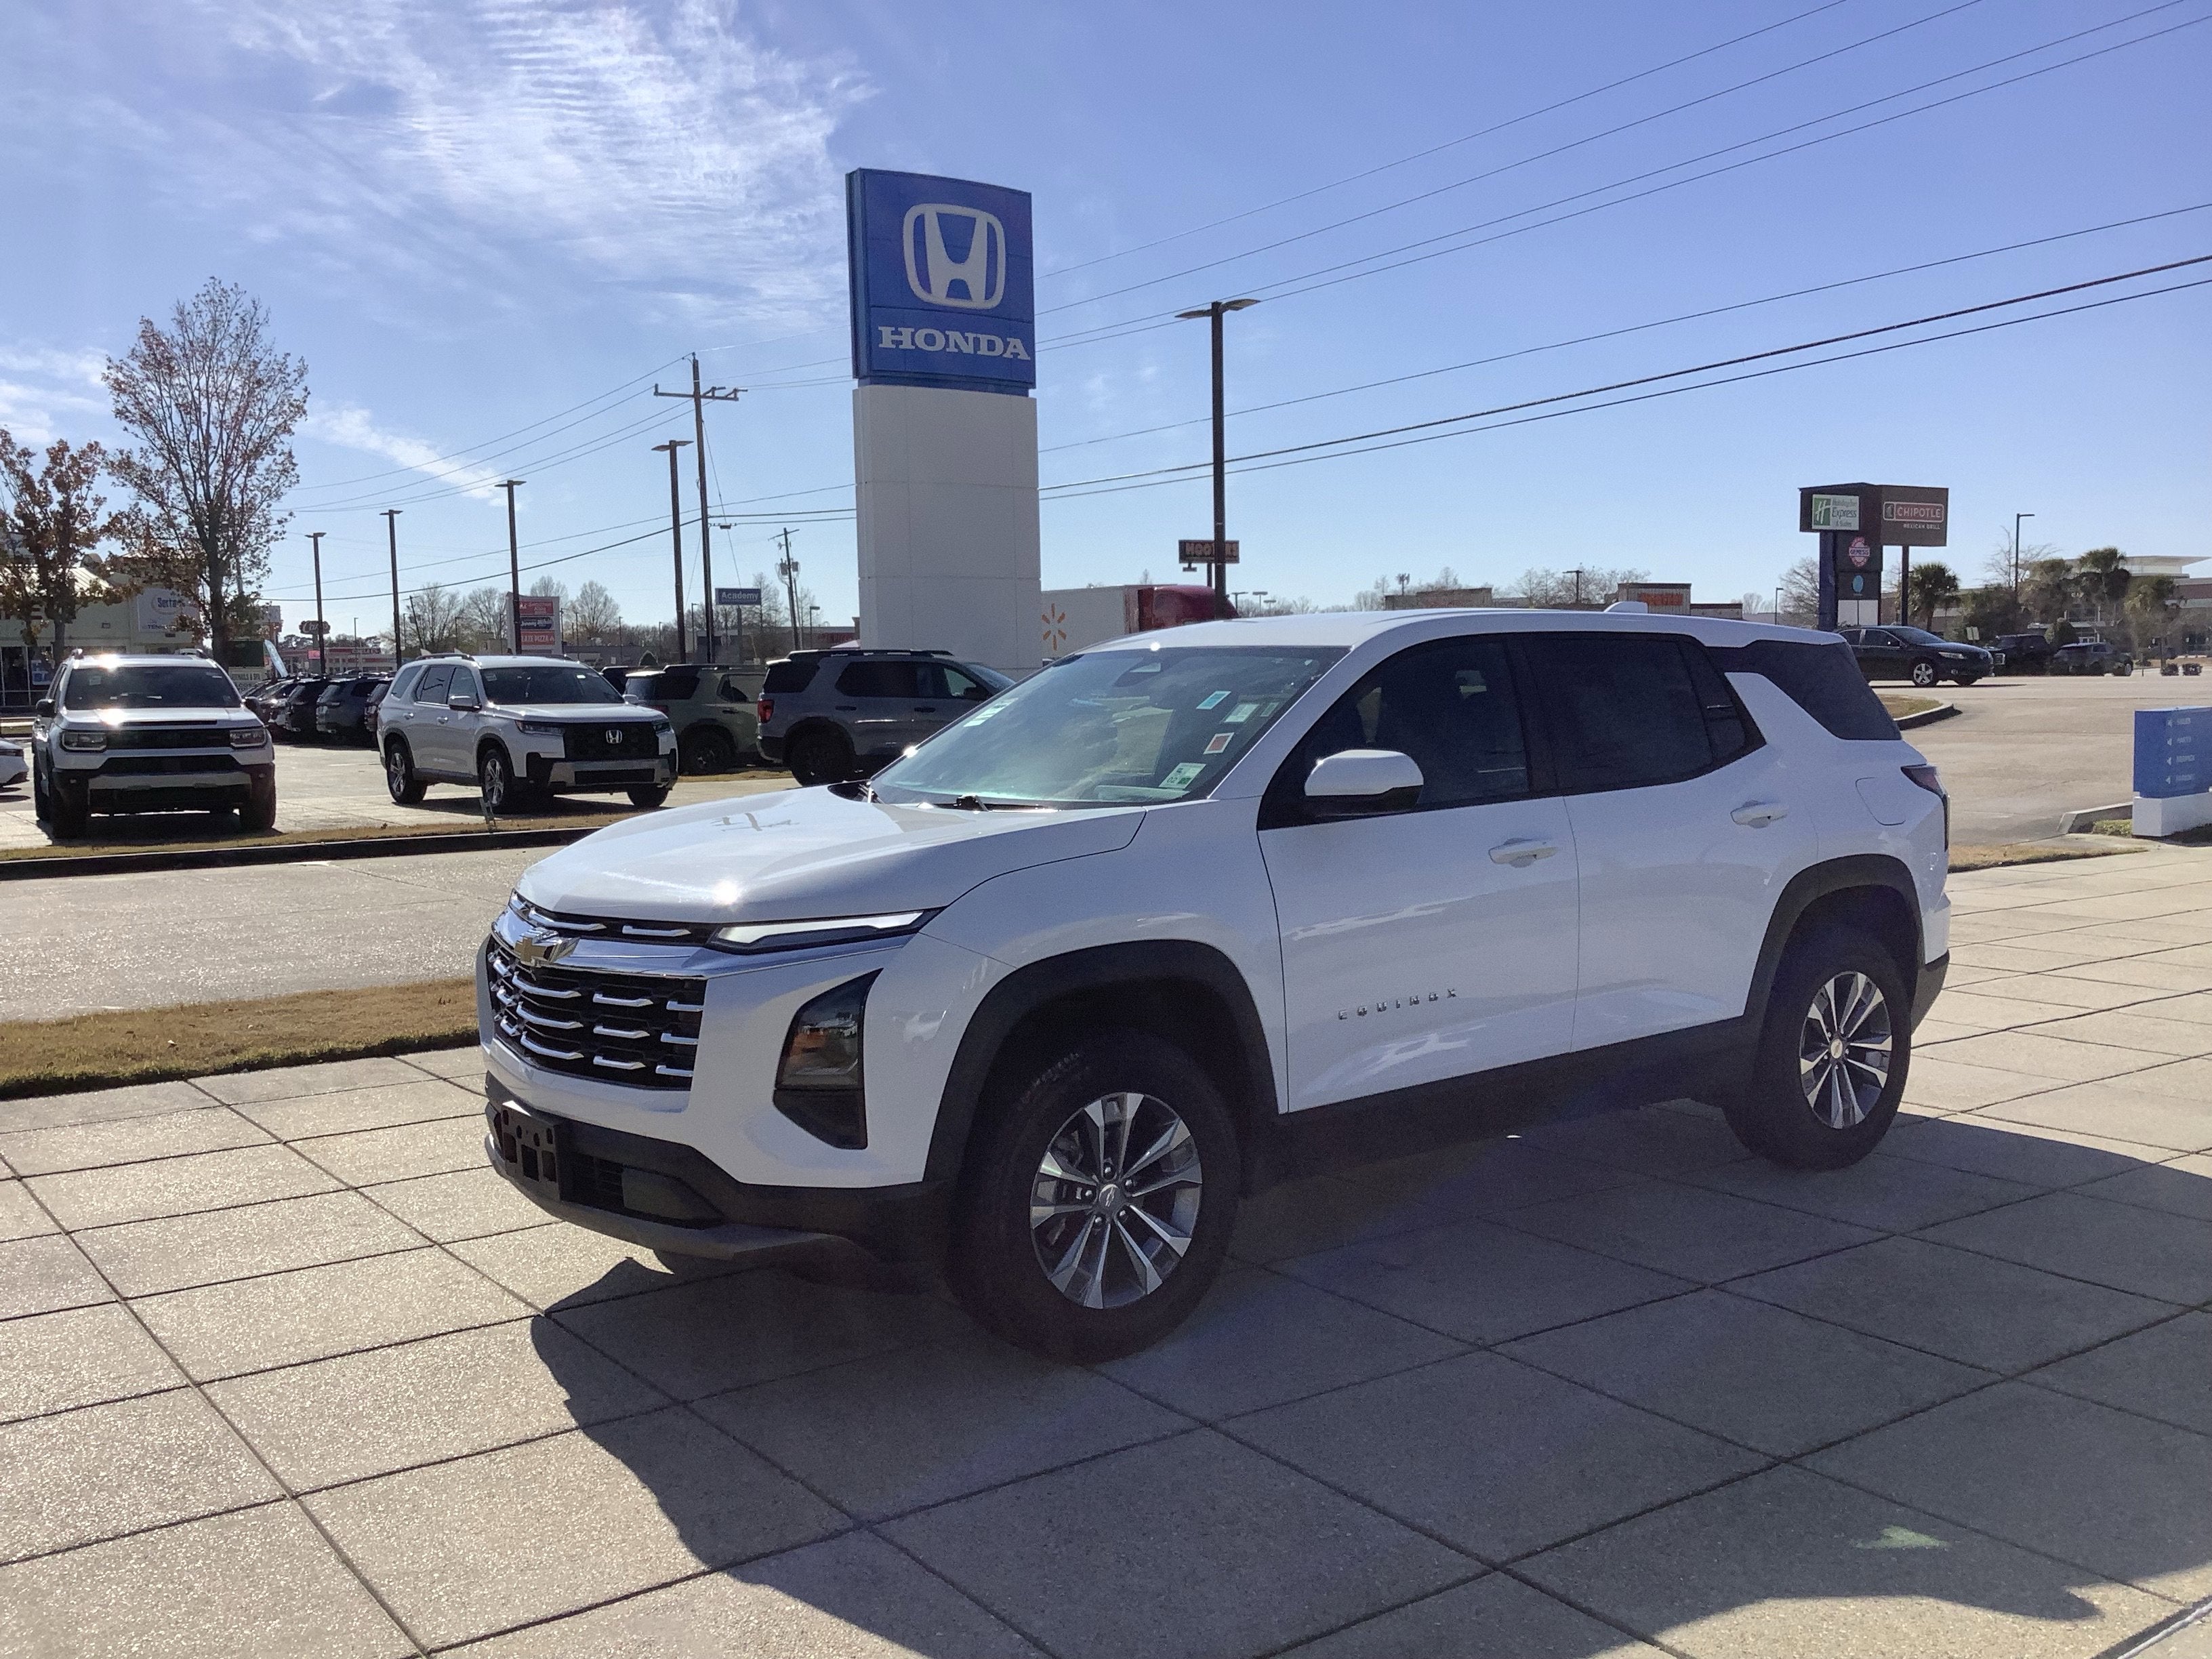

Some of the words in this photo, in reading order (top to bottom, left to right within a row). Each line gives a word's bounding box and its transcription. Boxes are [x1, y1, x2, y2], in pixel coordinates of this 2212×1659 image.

[878, 326, 1031, 361] HONDA
[1832, 506, 1857, 520] Express
[1897, 506, 1941, 518] CHIPOTLE
[721, 591, 758, 602] Academy
[1338, 988, 1457, 1021] EQUINOX
